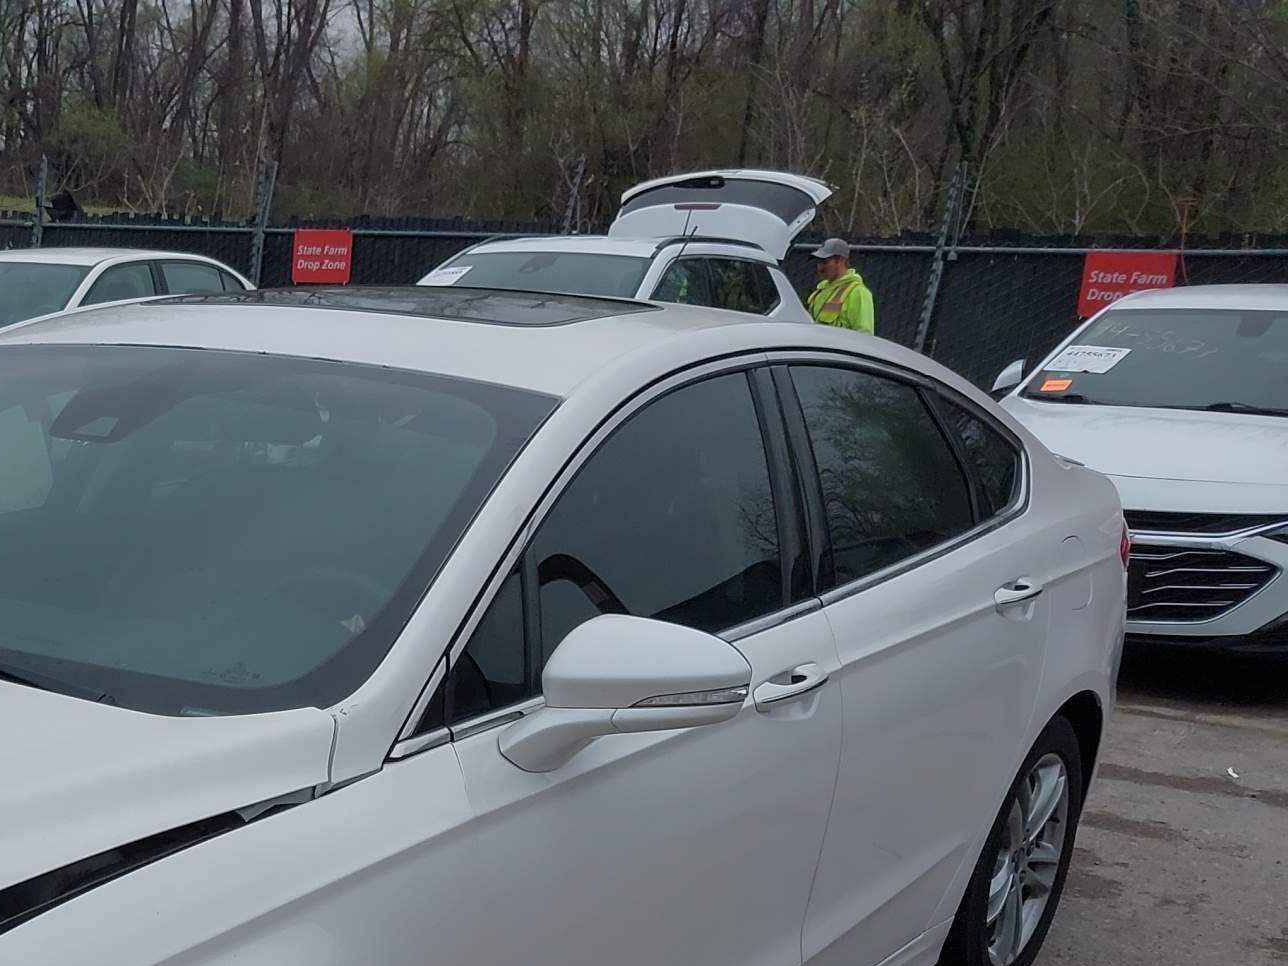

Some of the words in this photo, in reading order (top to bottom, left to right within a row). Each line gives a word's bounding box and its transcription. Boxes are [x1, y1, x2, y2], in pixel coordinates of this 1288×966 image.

[297, 245, 322, 256] State
[323, 245, 348, 256] Farm
[297, 260, 320, 272] Drop
[322, 260, 346, 270] Zone
[1089, 270, 1127, 283] State
[1130, 272, 1168, 285] Farm
